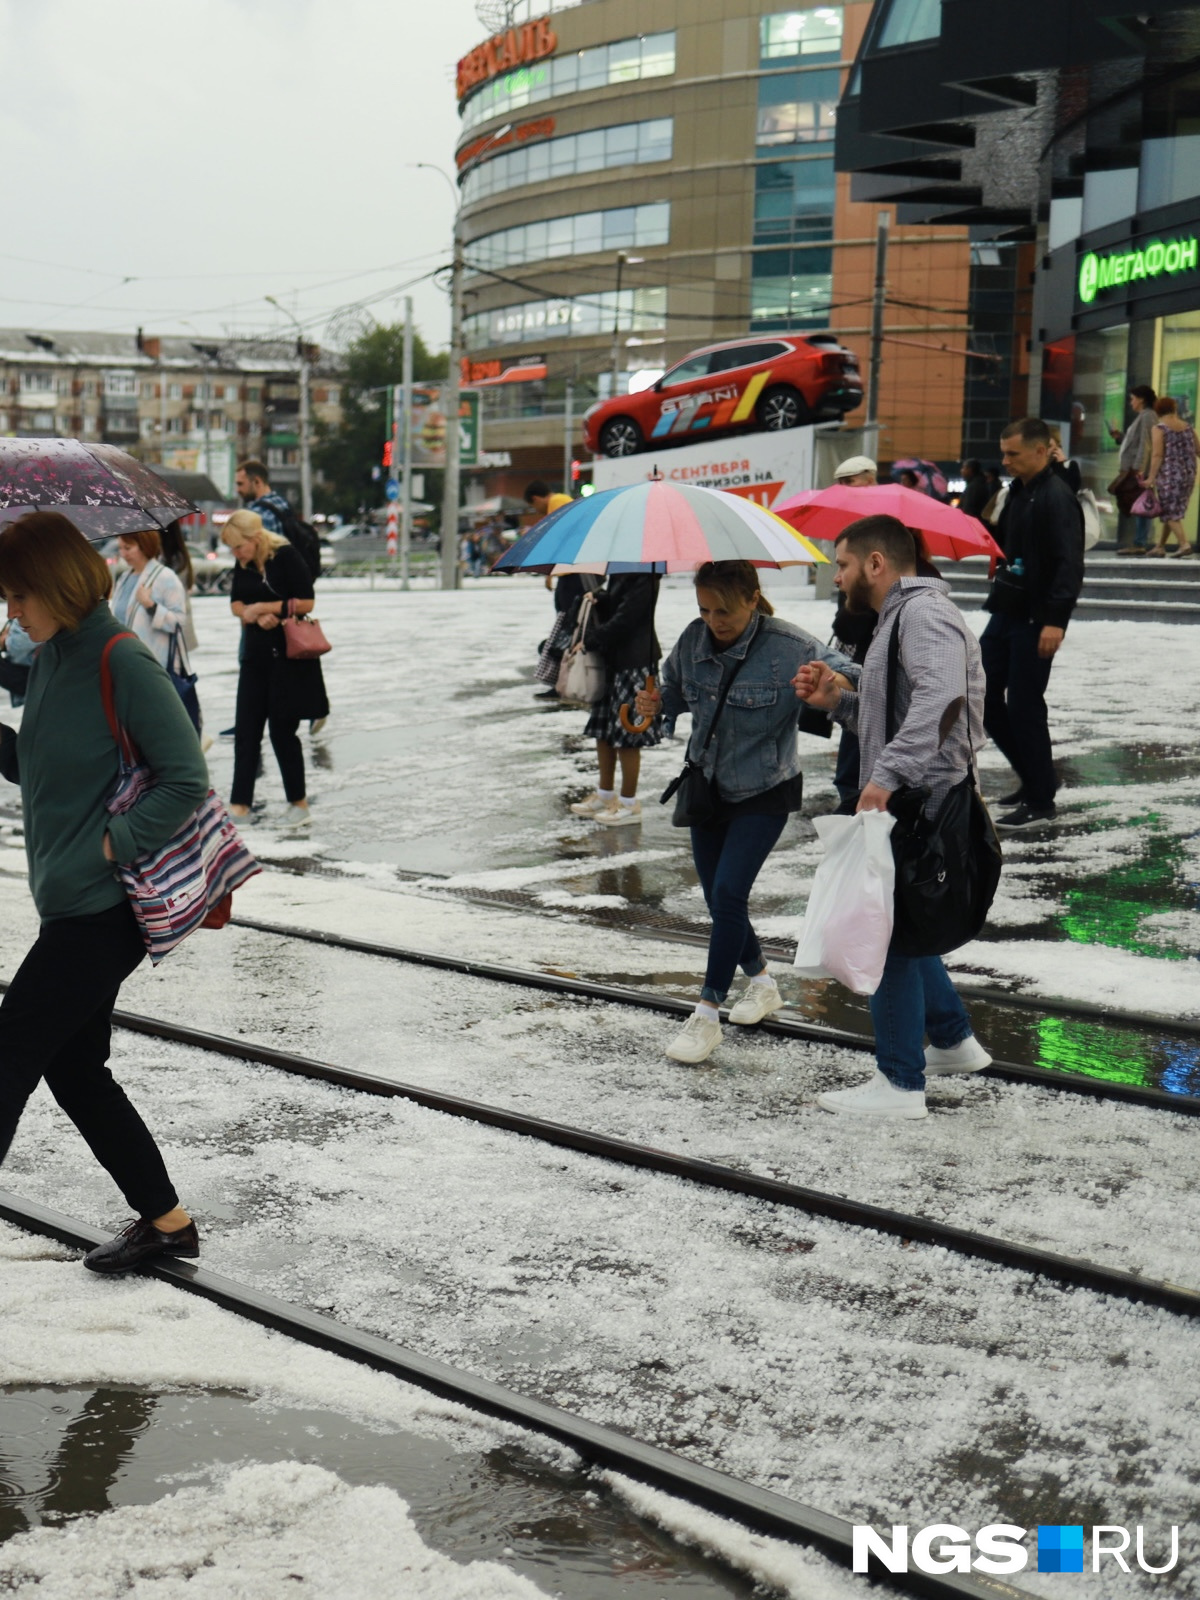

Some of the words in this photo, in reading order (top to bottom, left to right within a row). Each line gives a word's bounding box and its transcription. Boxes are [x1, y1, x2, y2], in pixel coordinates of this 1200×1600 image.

[670, 459, 751, 481] СЕНТЯБРЯ
[696, 474, 751, 488] ПРИЗОВ
[755, 471, 774, 481] НА
